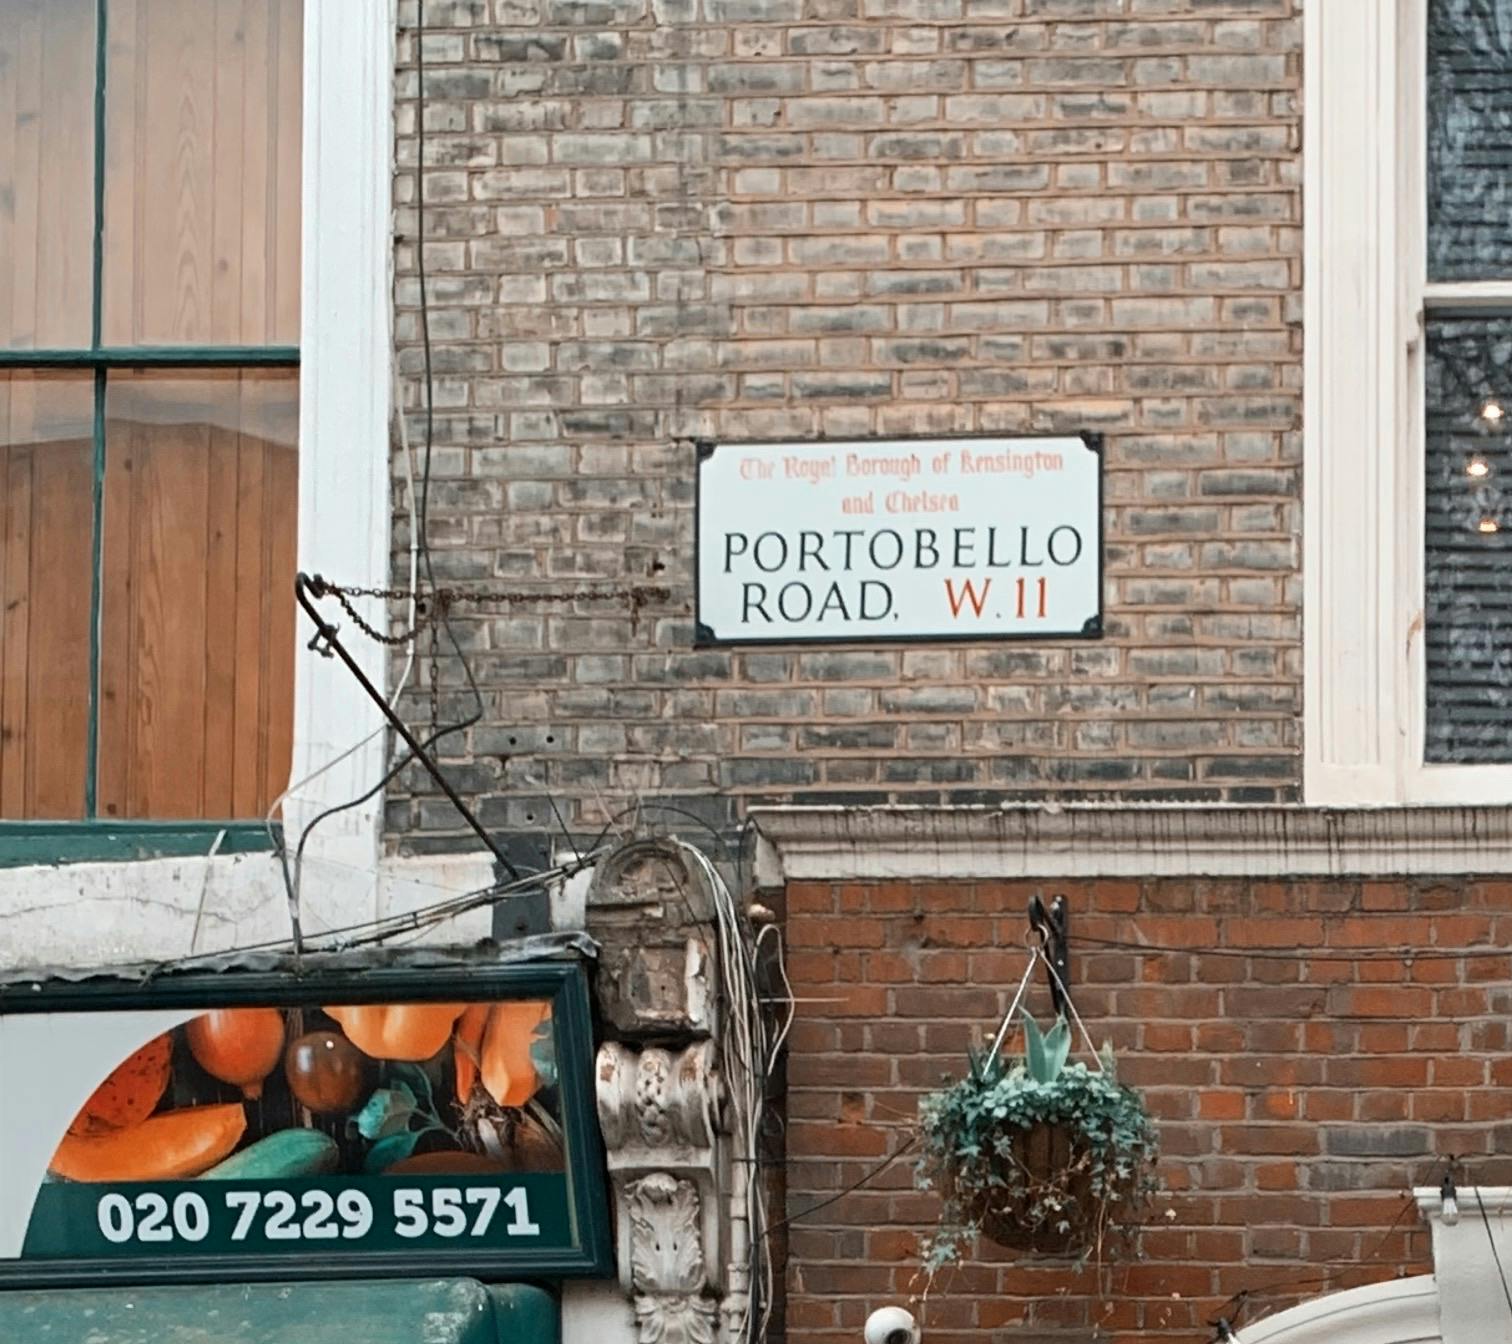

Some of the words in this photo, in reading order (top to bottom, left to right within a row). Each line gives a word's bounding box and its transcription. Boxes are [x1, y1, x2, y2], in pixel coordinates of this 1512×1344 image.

[845, 452, 921, 483] Borough
[932, 451, 952, 474] of
[960, 449, 1064, 479] Kensington
[841, 492, 874, 514] and
[885, 490, 960, 514] Chelsea
[723, 524, 1083, 573] PORTOBELLO
[740, 580, 899, 624] ROAD,
[99, 1191, 209, 1243] 020
[225, 1189, 374, 1240] 7229
[393, 1186, 540, 1237] 5571
